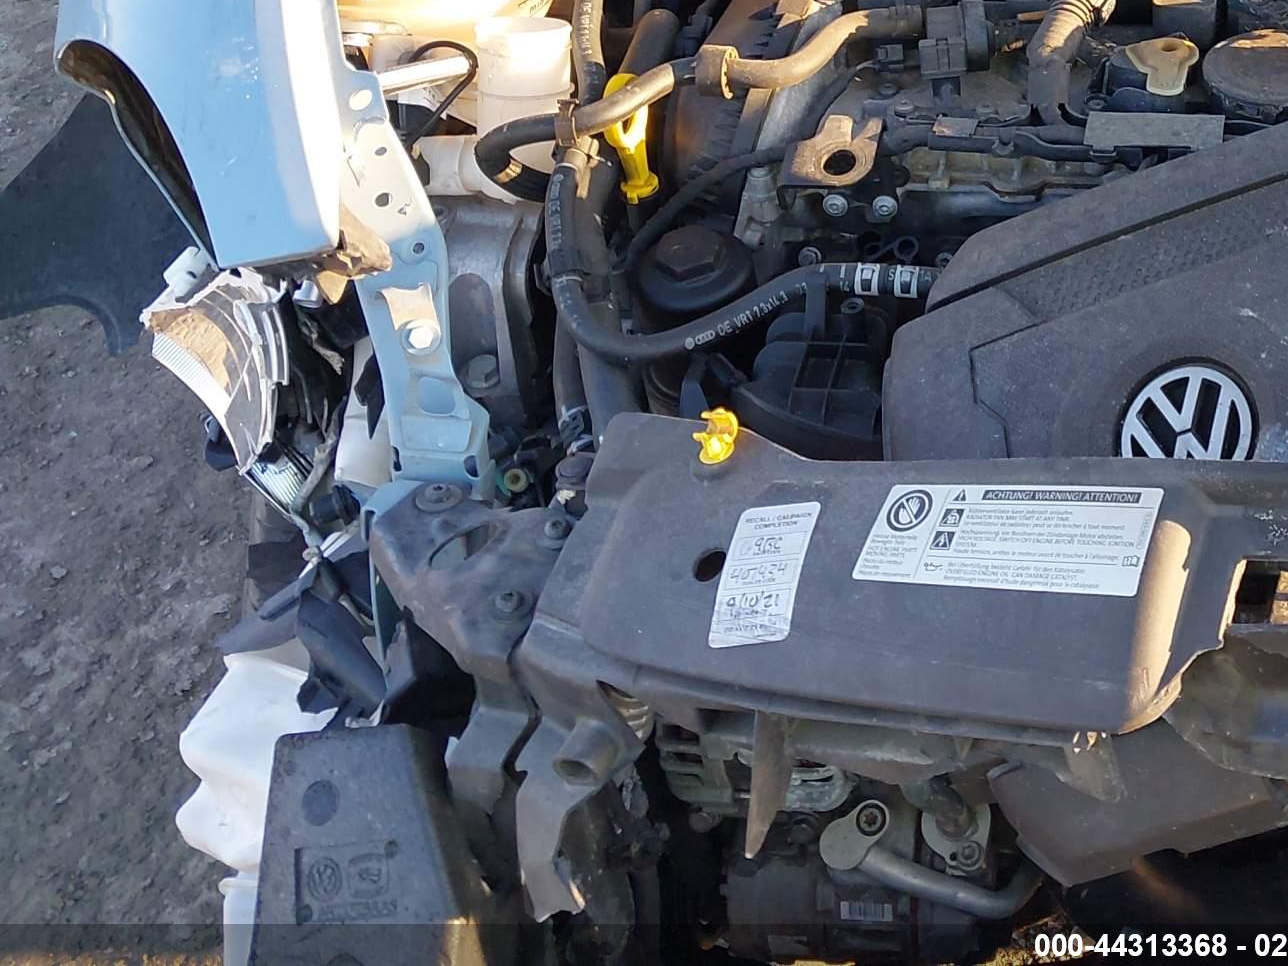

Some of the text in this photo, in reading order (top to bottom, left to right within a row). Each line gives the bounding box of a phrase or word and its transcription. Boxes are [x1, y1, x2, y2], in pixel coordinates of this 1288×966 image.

[986, 491, 1139, 502] ACHTUNG! WARNING! ATTENTION!
